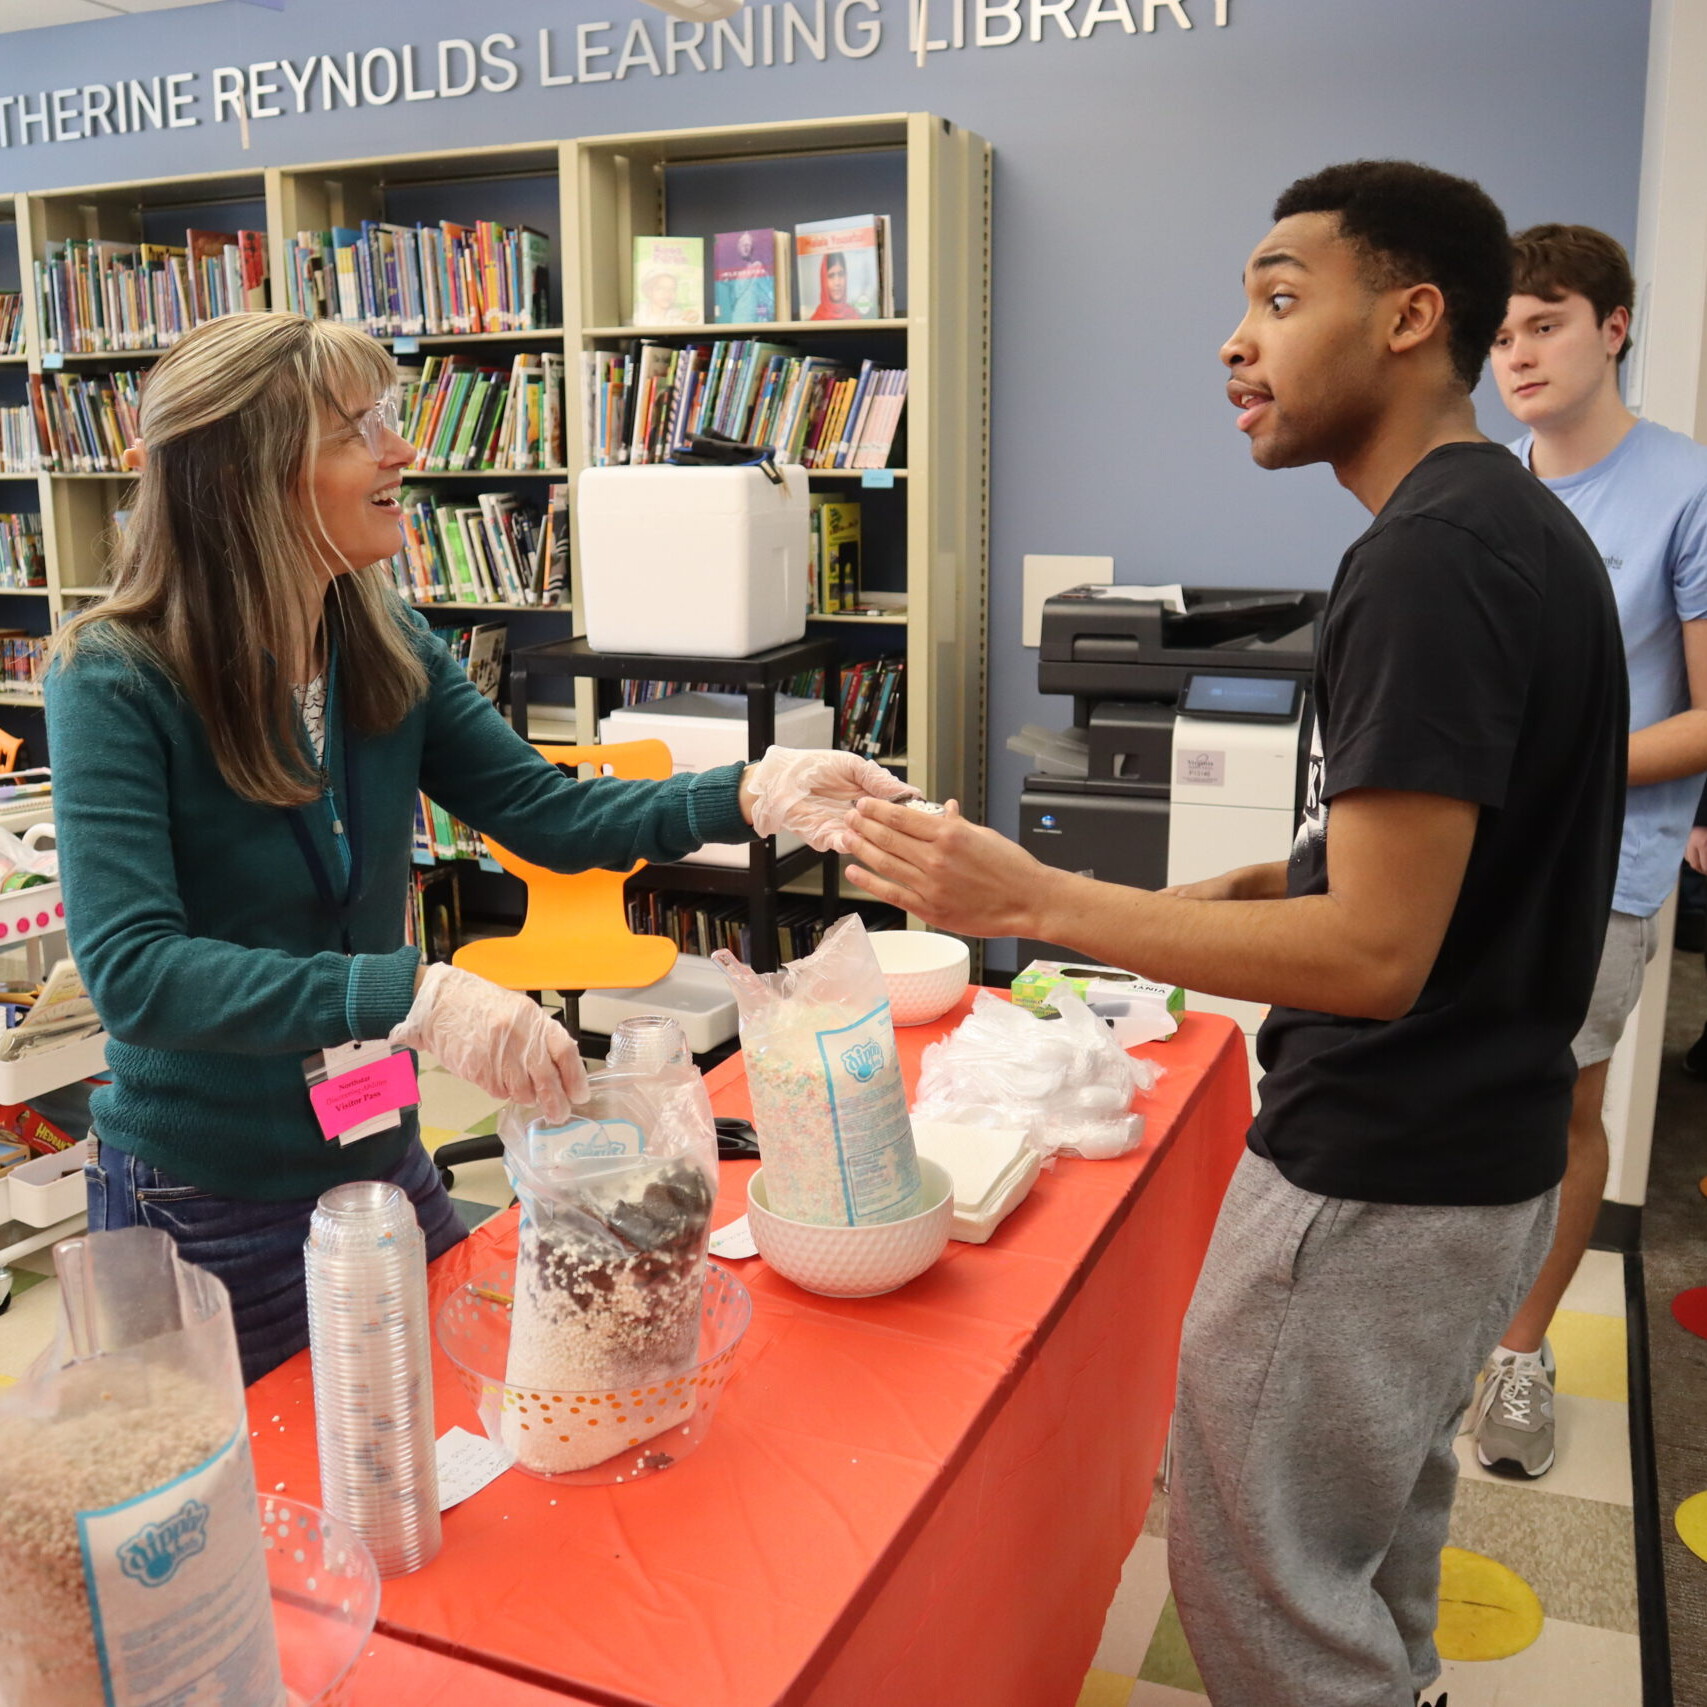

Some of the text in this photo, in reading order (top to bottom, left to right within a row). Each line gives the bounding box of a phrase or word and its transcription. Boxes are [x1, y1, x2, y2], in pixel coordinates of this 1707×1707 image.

[213, 33, 518, 122] REYNOLDS
[538, 0, 881, 87] LEARNING
[335, 1091, 382, 1111] Visitor Pass
